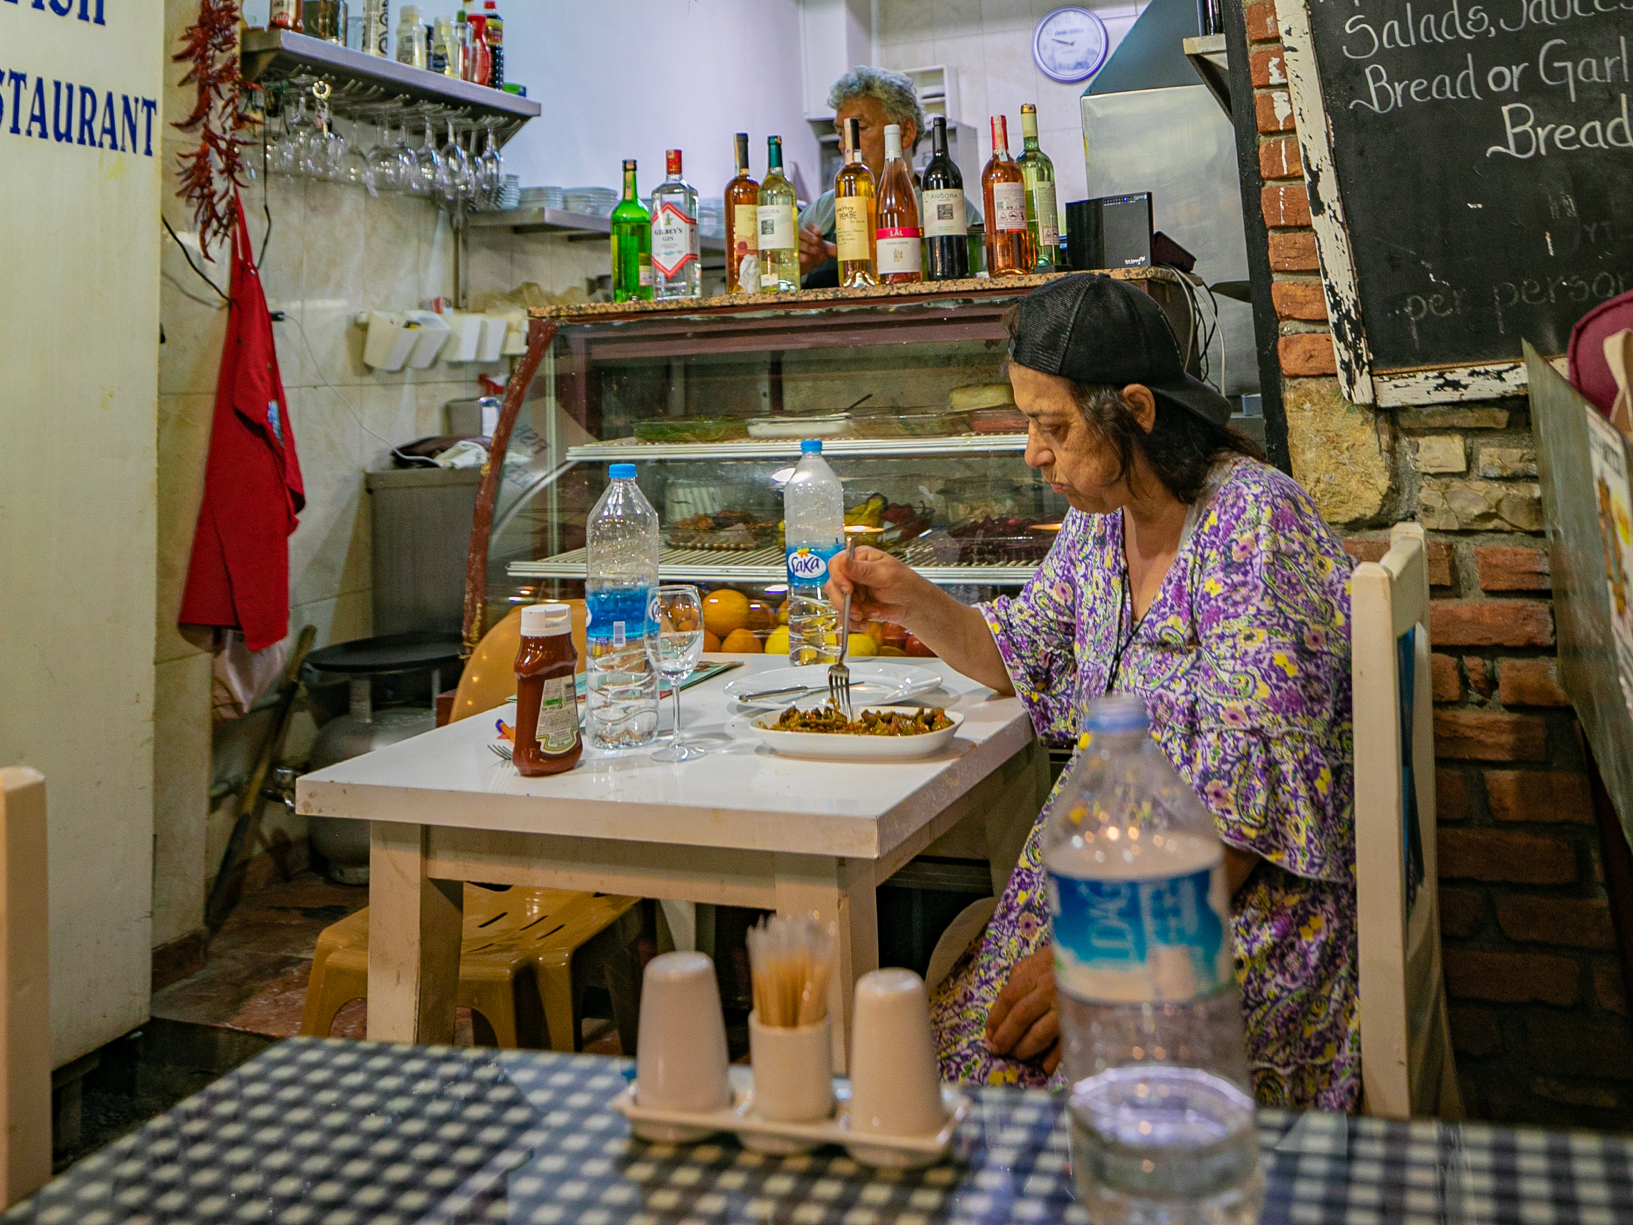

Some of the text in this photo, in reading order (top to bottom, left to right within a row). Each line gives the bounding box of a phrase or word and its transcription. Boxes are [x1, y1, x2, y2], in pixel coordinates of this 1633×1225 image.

[0, 68, 157, 157] TAURANT
[1349, 53, 1484, 113] Bread
[1487, 62, 1530, 92] or
[1486, 94, 1633, 158] Bread
